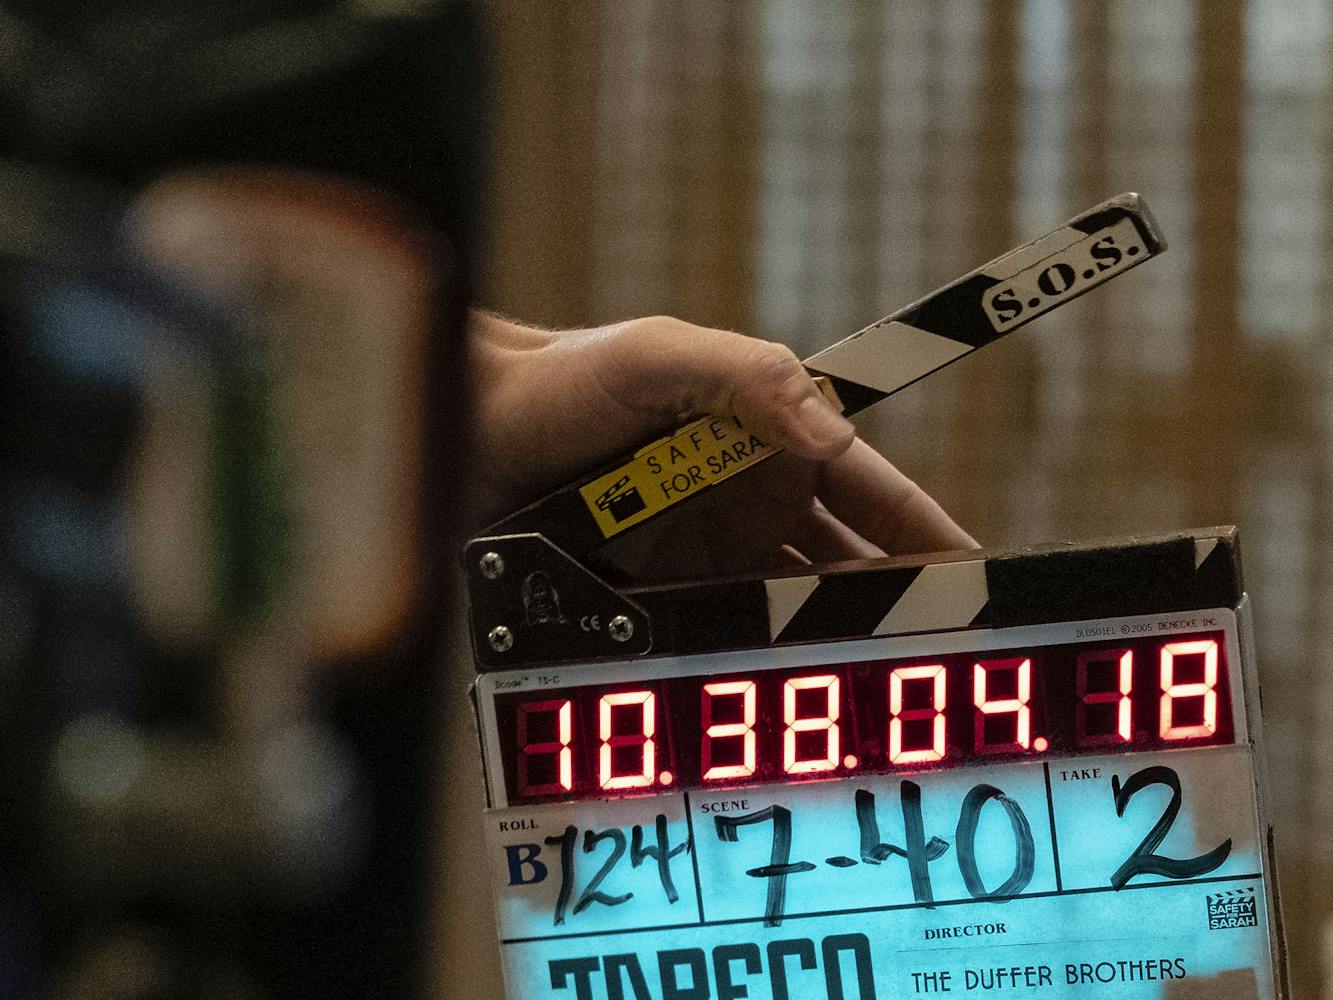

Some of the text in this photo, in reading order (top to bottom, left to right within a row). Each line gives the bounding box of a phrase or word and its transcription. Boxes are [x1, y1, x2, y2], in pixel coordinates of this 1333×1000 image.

[992, 236, 1140, 324] S.O.S.
[660, 434, 768, 499] FOR SARA
[1158, 619, 1198, 631] DENECKE
[1060, 768, 1102, 782] TAKE
[701, 799, 750, 813] SCENE
[499, 819, 539, 832] ROLL
[1110, 765, 1232, 891] 2
[714, 780, 1035, 928] 7-40
[1210, 902, 1254, 915] SAFETY
[1210, 916, 1255, 929] SARAH
[924, 923, 1007, 940] DIRECTOR
[911, 958, 1187, 993] THE DUFFER BROTHERS
